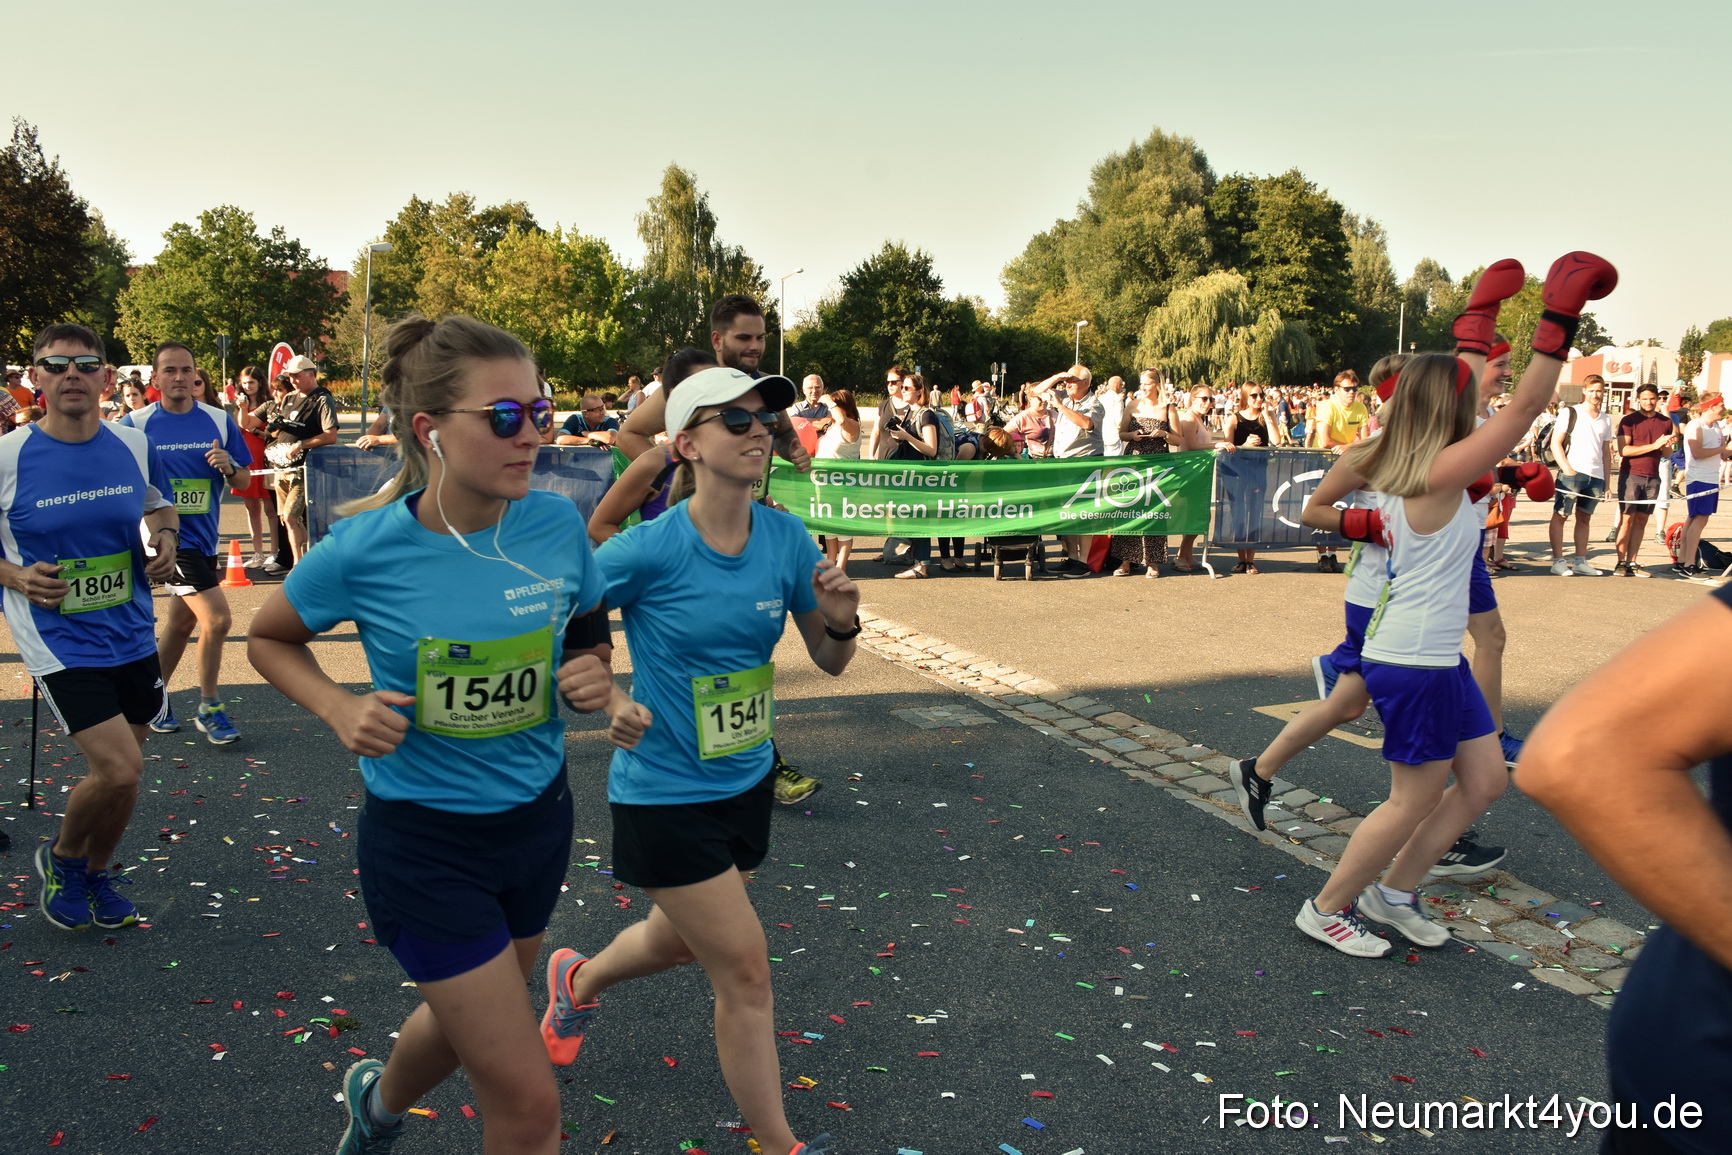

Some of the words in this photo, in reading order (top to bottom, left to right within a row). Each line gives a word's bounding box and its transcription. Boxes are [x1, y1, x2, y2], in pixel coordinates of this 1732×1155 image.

[810, 468, 959, 487] Gesundheit
[1062, 466, 1175, 508] AOK
[36, 484, 134, 508] energiegeladen
[173, 491, 206, 504] 1807
[809, 497, 833, 518] in
[842, 497, 926, 519] besten
[936, 498, 1033, 519] Händen
[1059, 510, 1078, 520] Die
[1079, 510, 1172, 520] Gesundheitskasse.
[70, 571, 125, 598] 1804
[508, 601, 549, 617] Verena
[436, 667, 537, 712] 1540
[449, 711, 489, 722] Gruber
[710, 693, 766, 733] 1541
